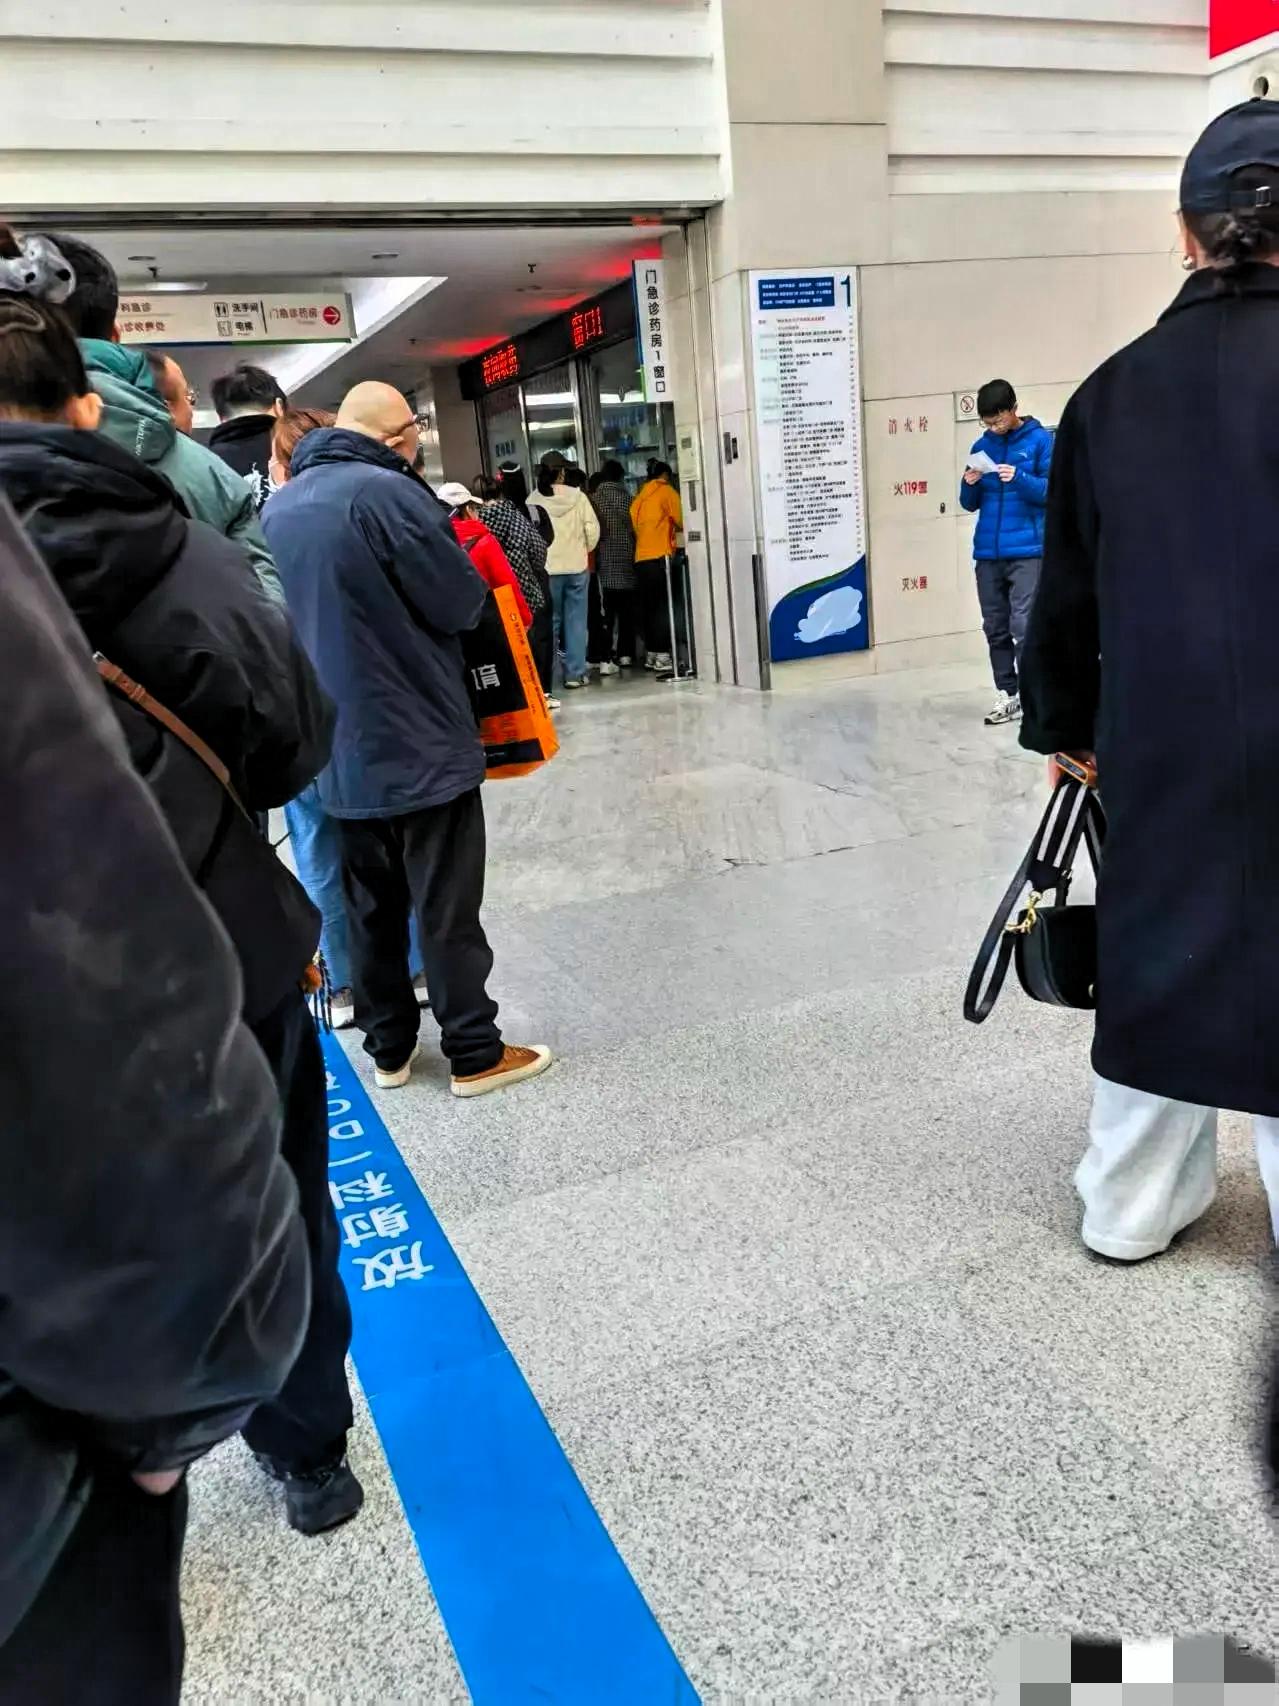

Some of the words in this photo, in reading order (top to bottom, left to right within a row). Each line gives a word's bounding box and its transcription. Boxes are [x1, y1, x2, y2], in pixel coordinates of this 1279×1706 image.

[840, 275, 852, 307] 1
[231, 303, 259, 313] 洗手间
[270, 308, 318, 320] 门急诊药房
[119, 321, 166, 333] 诊收费处
[645, 270, 666, 393] 门急诊药房1窗口
[902, 576, 928, 591] 灭火器
[329, 1170, 434, 1291] 放射科
